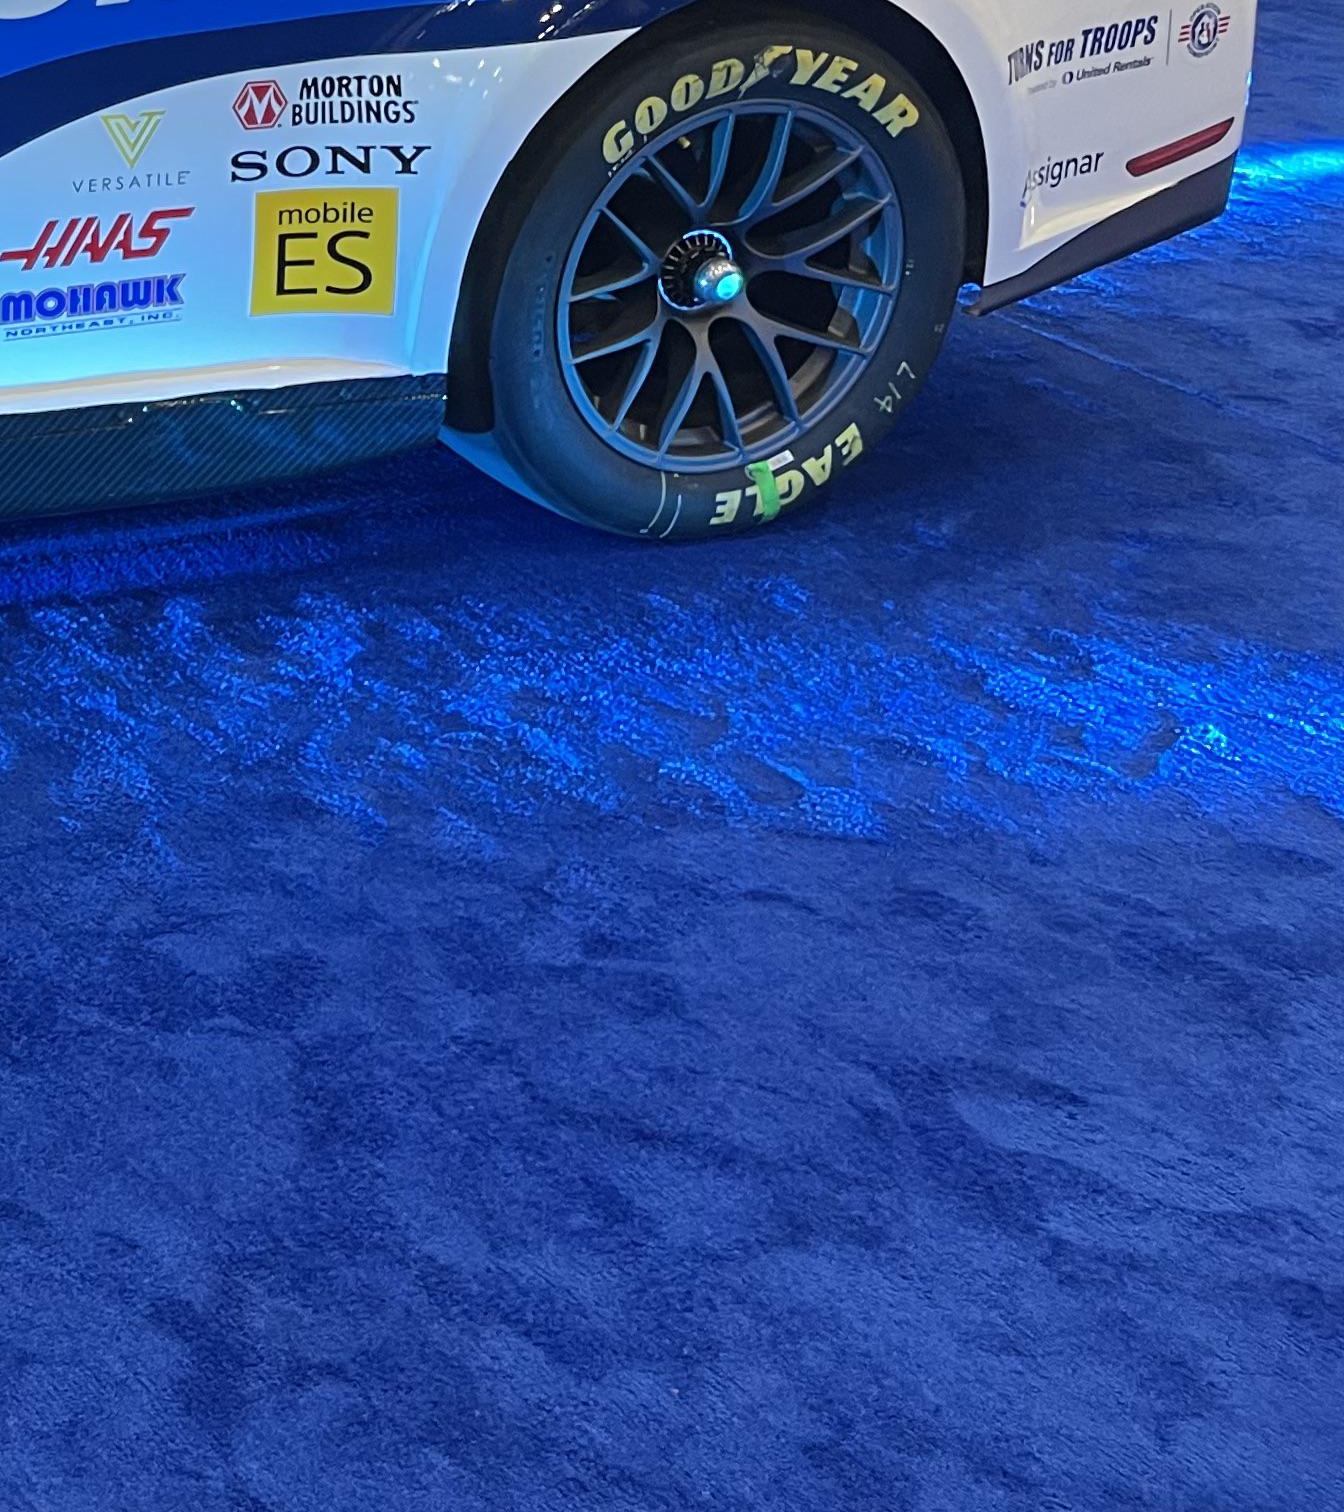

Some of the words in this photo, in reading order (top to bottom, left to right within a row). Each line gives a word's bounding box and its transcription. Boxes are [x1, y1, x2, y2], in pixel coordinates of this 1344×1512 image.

[1046, 39, 1075, 68] FOR
[1079, 15, 1159, 59] TROOPS
[1076, 64, 1111, 82] United
[1112, 56, 1154, 73] Rentals
[298, 75, 402, 101] MORTON
[291, 99, 417, 126] BUILDINGS
[601, 45, 920, 167] GOODYEAR
[230, 145, 432, 183] SONY
[72, 171, 191, 193] VERSATILE
[278, 201, 374, 225] mobile
[275, 230, 373, 297] ES
[710, 422, 863, 527] EAGLE
